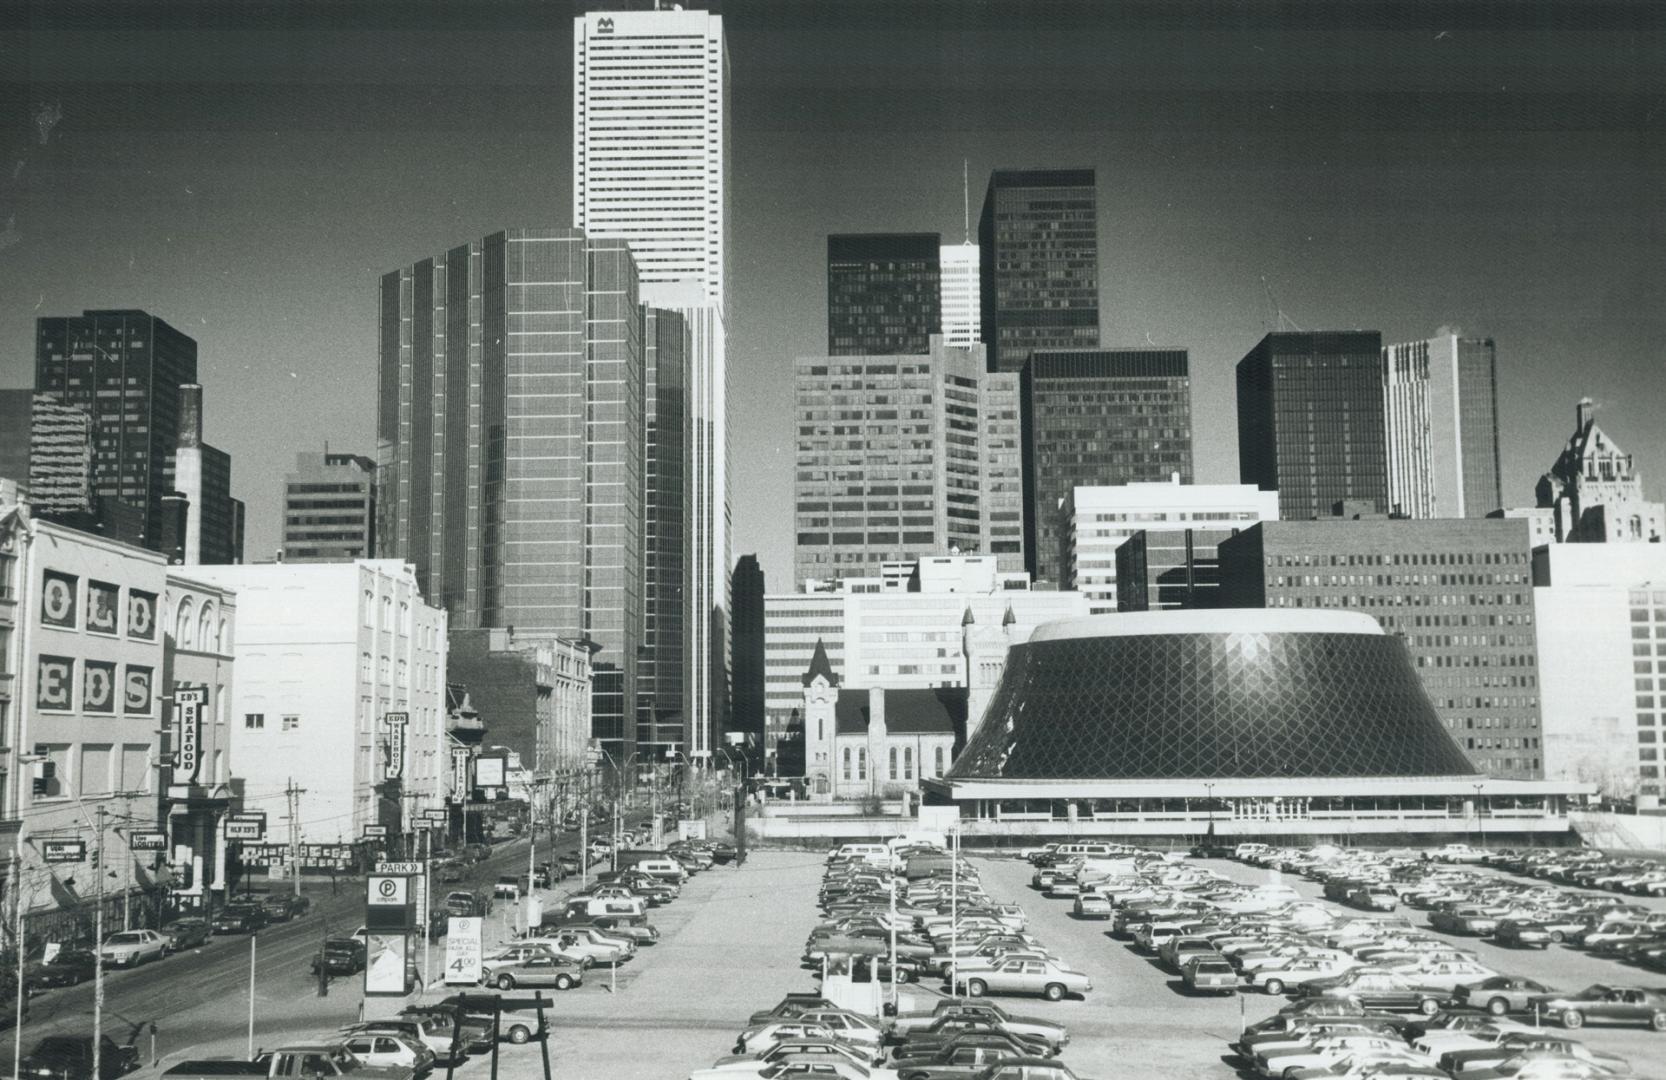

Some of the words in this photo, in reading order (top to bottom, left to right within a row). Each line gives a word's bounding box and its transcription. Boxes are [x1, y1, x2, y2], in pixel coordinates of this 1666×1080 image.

[44, 578, 151, 633] OLD
[184, 706, 194, 770] SEAFOOD
[380, 863, 408, 872] PARK
[448, 937, 479, 945] SPECIAL
